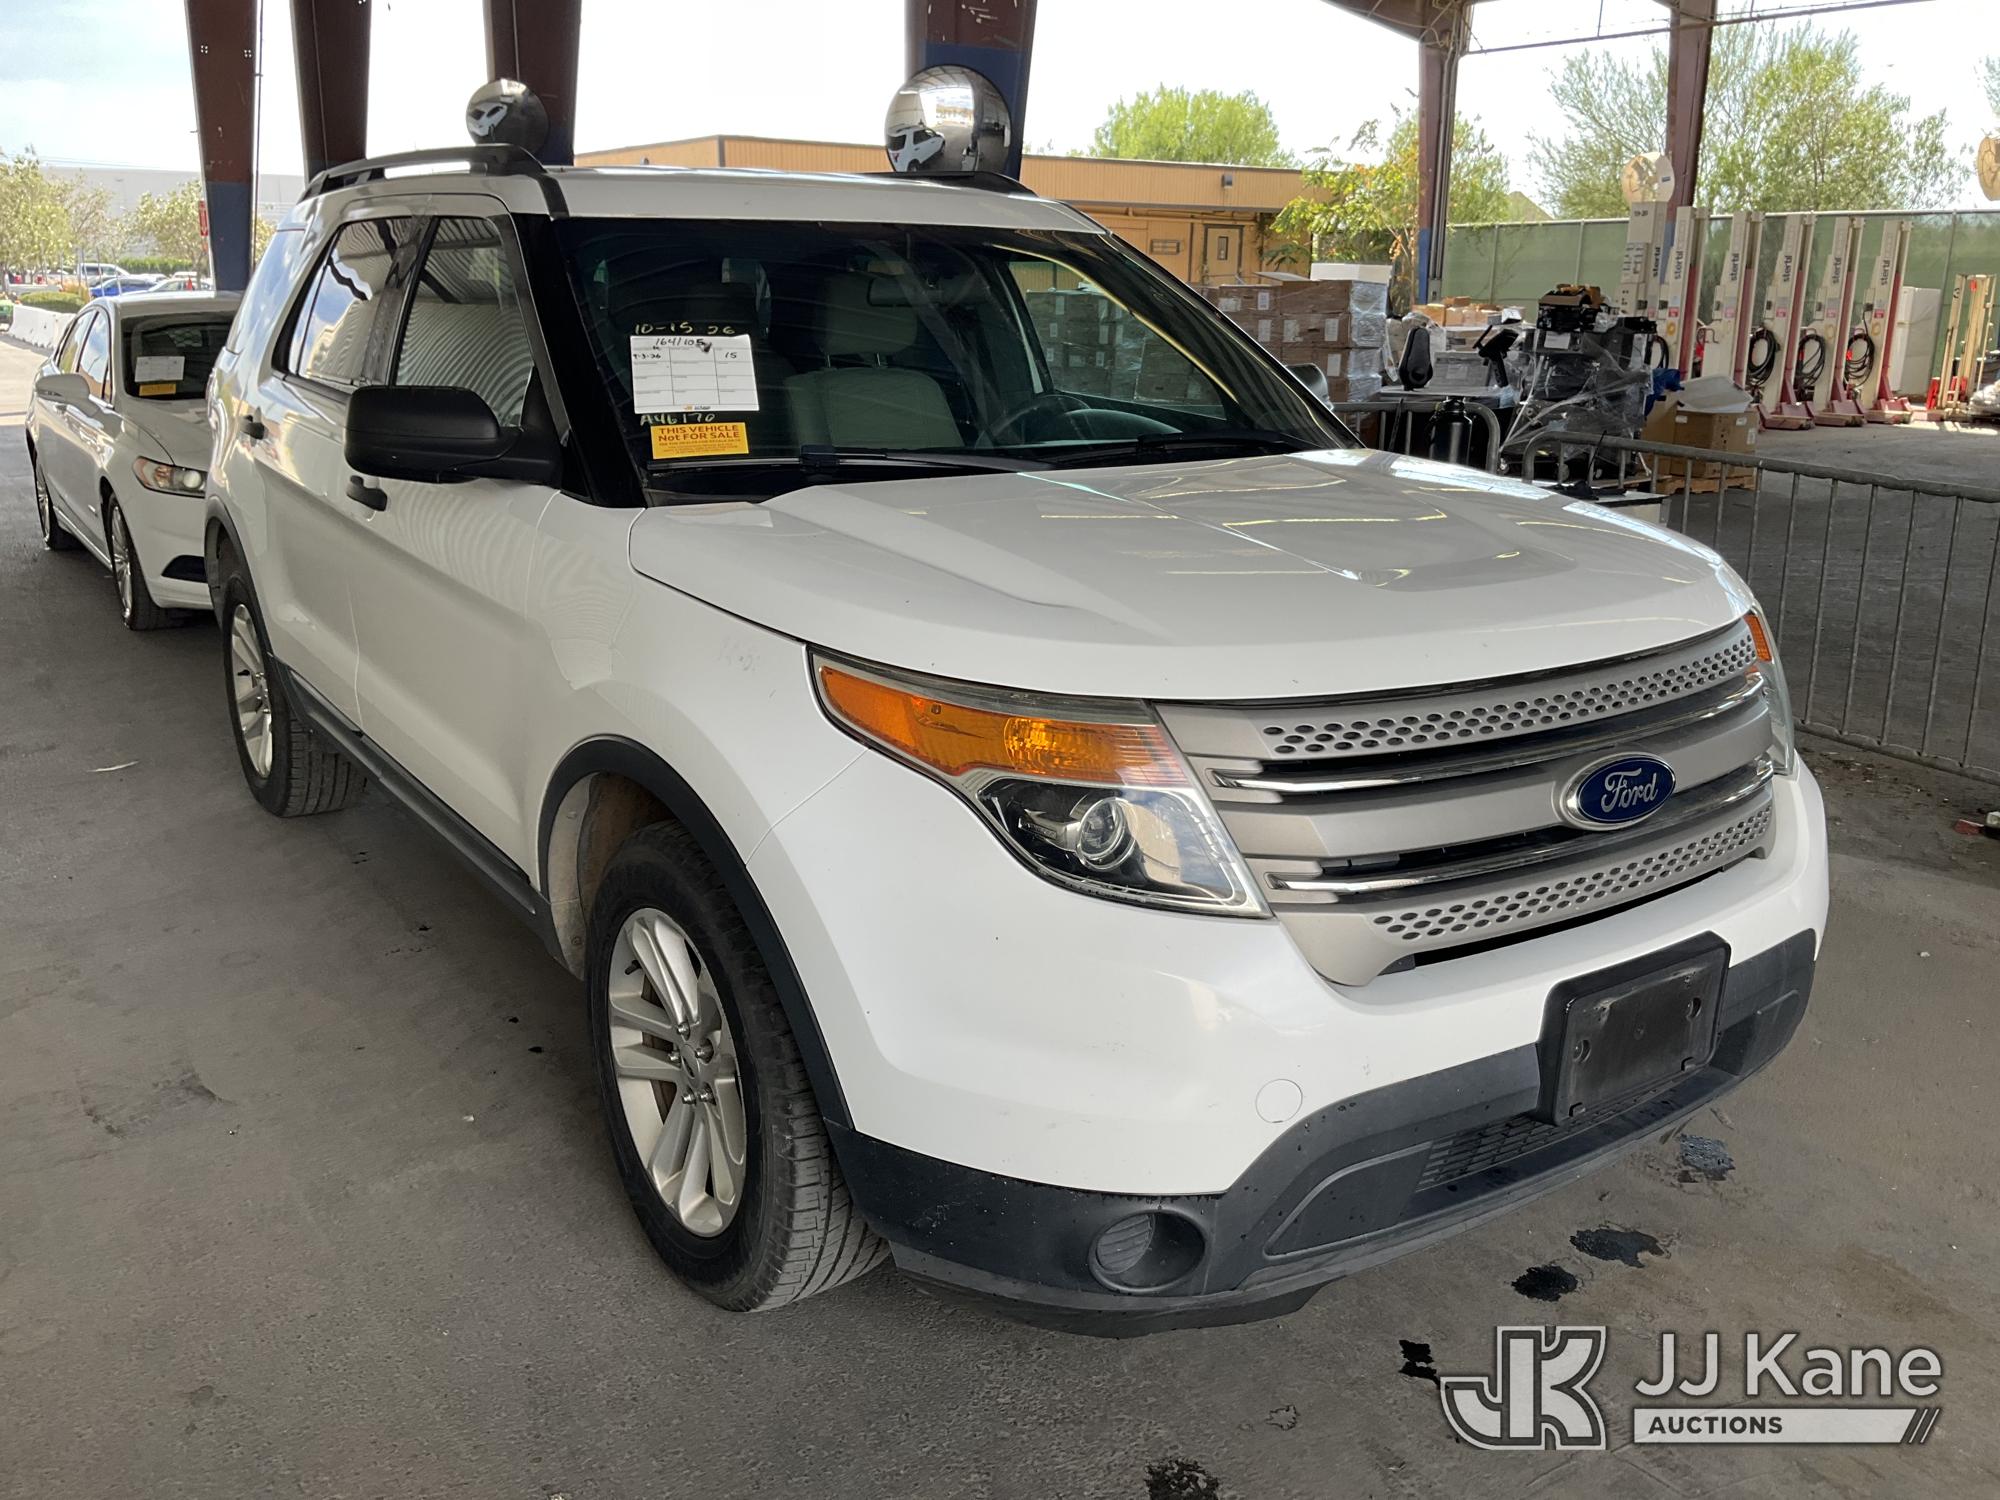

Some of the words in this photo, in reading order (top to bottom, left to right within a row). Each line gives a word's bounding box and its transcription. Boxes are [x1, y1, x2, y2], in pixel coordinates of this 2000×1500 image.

[659, 427, 687, 435] THIS
[688, 425, 740, 433] VEHICLE
[658, 434, 681, 442] Not
[683, 432, 708, 440] FOR
[710, 431, 741, 439] SALE
[1600, 767, 1659, 813] Ford
